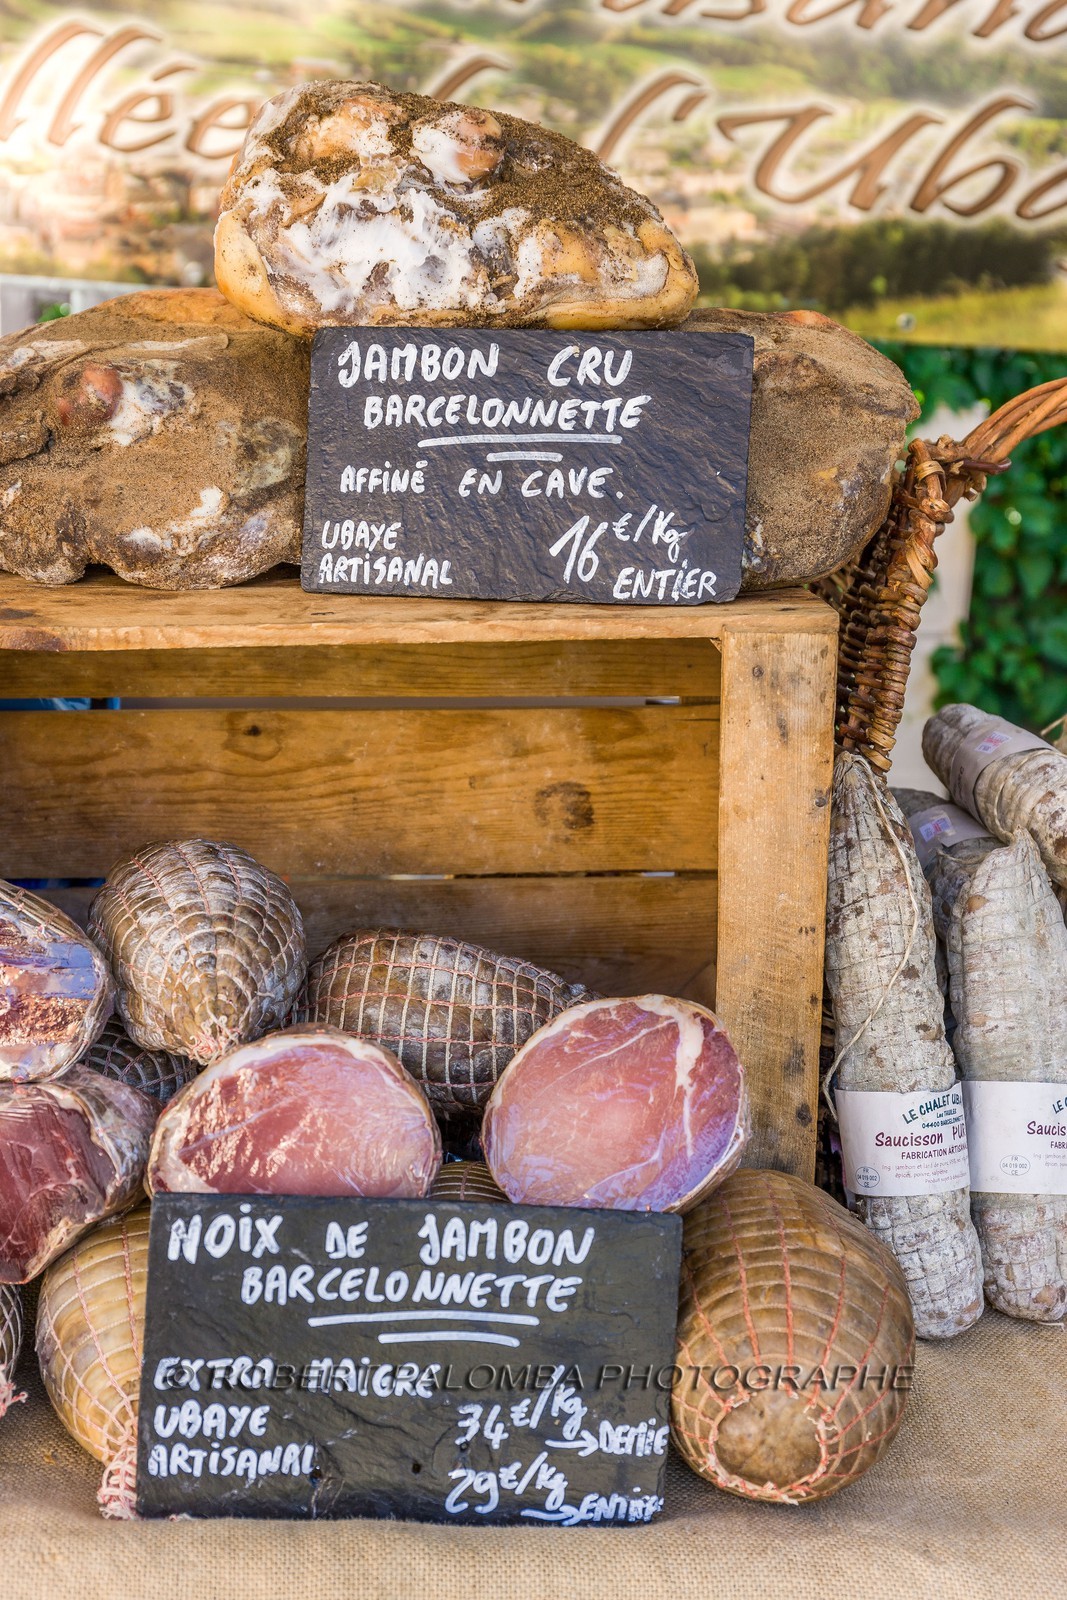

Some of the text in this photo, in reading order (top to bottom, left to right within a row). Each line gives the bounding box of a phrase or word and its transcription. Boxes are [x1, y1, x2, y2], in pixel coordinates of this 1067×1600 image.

[338, 341, 633, 388] JAMBON CRU
[363, 395, 652, 432] BARCELONNETTE
[459, 468, 500, 497] EN
[521, 467, 624, 499] CAVE.
[322, 521, 402, 552] UBAYE
[902, 1109, 919, 1124] LE
[919, 1094, 950, 1116] CHALET
[1052, 1100, 1064, 1114] LE
[875, 1131, 944, 1147] Saucisson
[1027, 1120, 1067, 1136] Saucis
[901, 1149, 948, 1160] FABRICATION
[325, 1221, 370, 1260] DE
[417, 1213, 595, 1267] JAMBON
[240, 1265, 583, 1312] BARCELONNETTE
[153, 1356, 276, 1391] EXTRA
[153, 1399, 271, 1439] UBAYE
